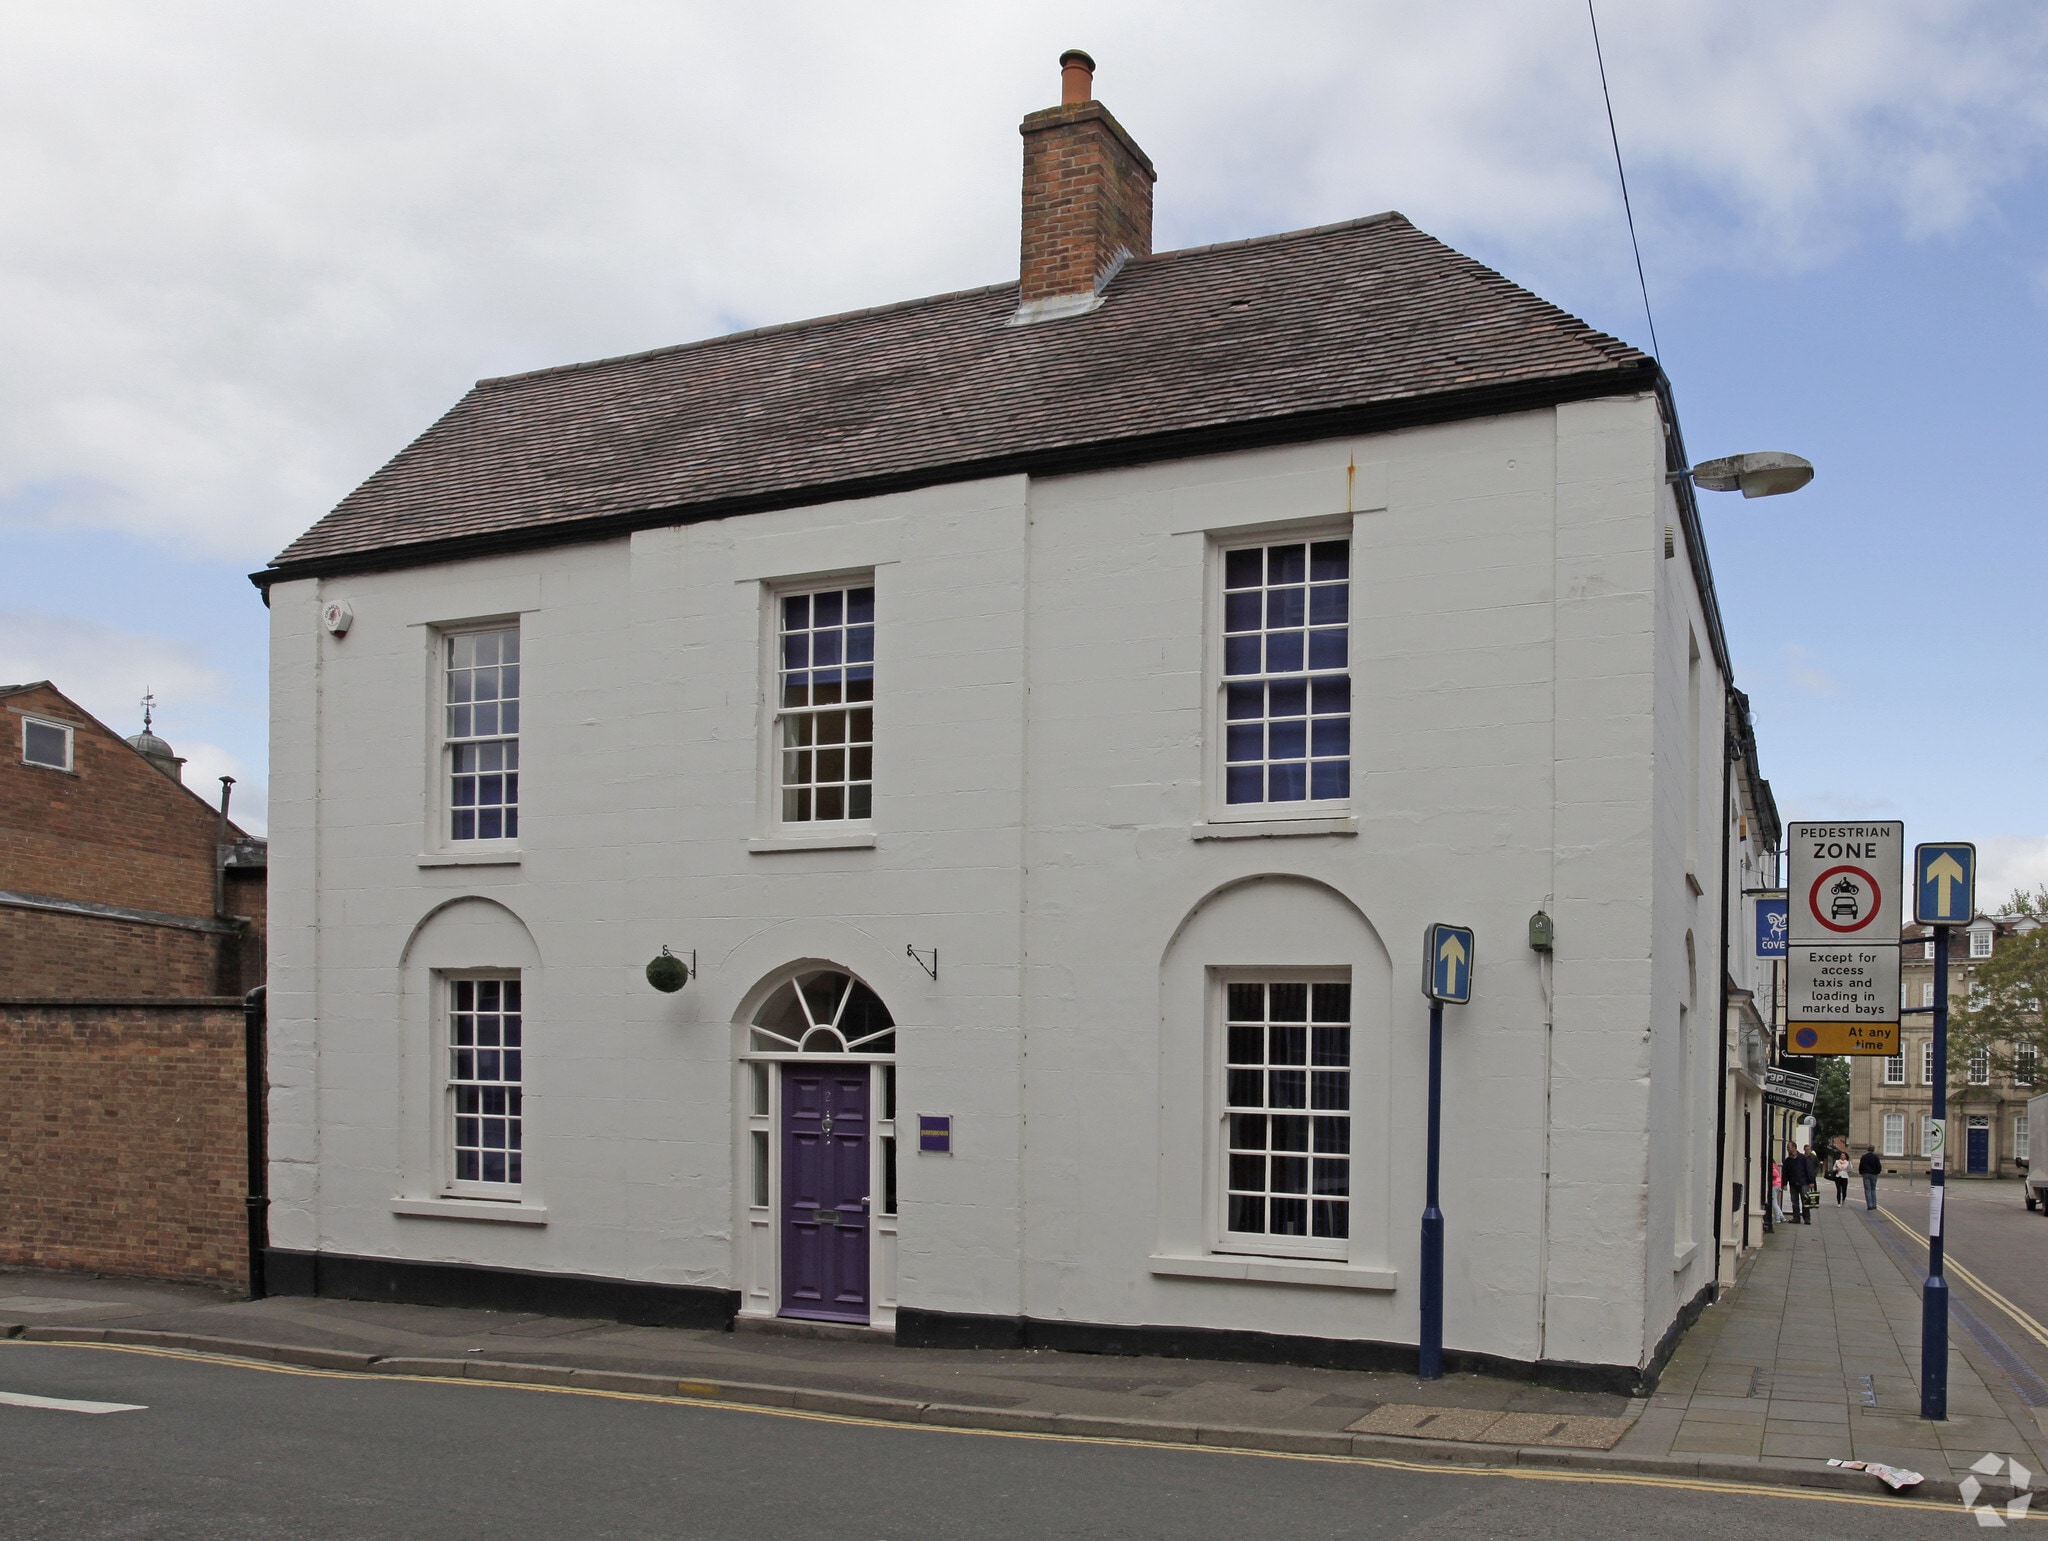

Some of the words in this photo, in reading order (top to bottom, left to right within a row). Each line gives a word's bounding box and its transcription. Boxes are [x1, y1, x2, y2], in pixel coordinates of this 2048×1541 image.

[1800, 827, 1890, 838] PEDESTRIAN
[1813, 843, 1877, 859] ZONE
[1762, 941, 1786, 950] COVE
[1809, 952, 1853, 964] Except
[1859, 952, 1877, 963] for
[1821, 966, 1864, 975] access
[1813, 978, 1843, 988] taxis
[1849, 978, 1872, 988] and
[1812, 991, 1858, 1002] loading
[1864, 991, 1875, 1001] in
[1802, 1004, 1850, 1013] marked
[1855, 1004, 1885, 1015] bays
[1848, 1027, 1863, 1037] At
[1869, 1029, 1892, 1039] any
[1855, 1040, 1884, 1050] time
[825, 1091, 831, 1102] 2
[1775, 1086, 1788, 1095] FOR
[1788, 1090, 1804, 1099] SALE
